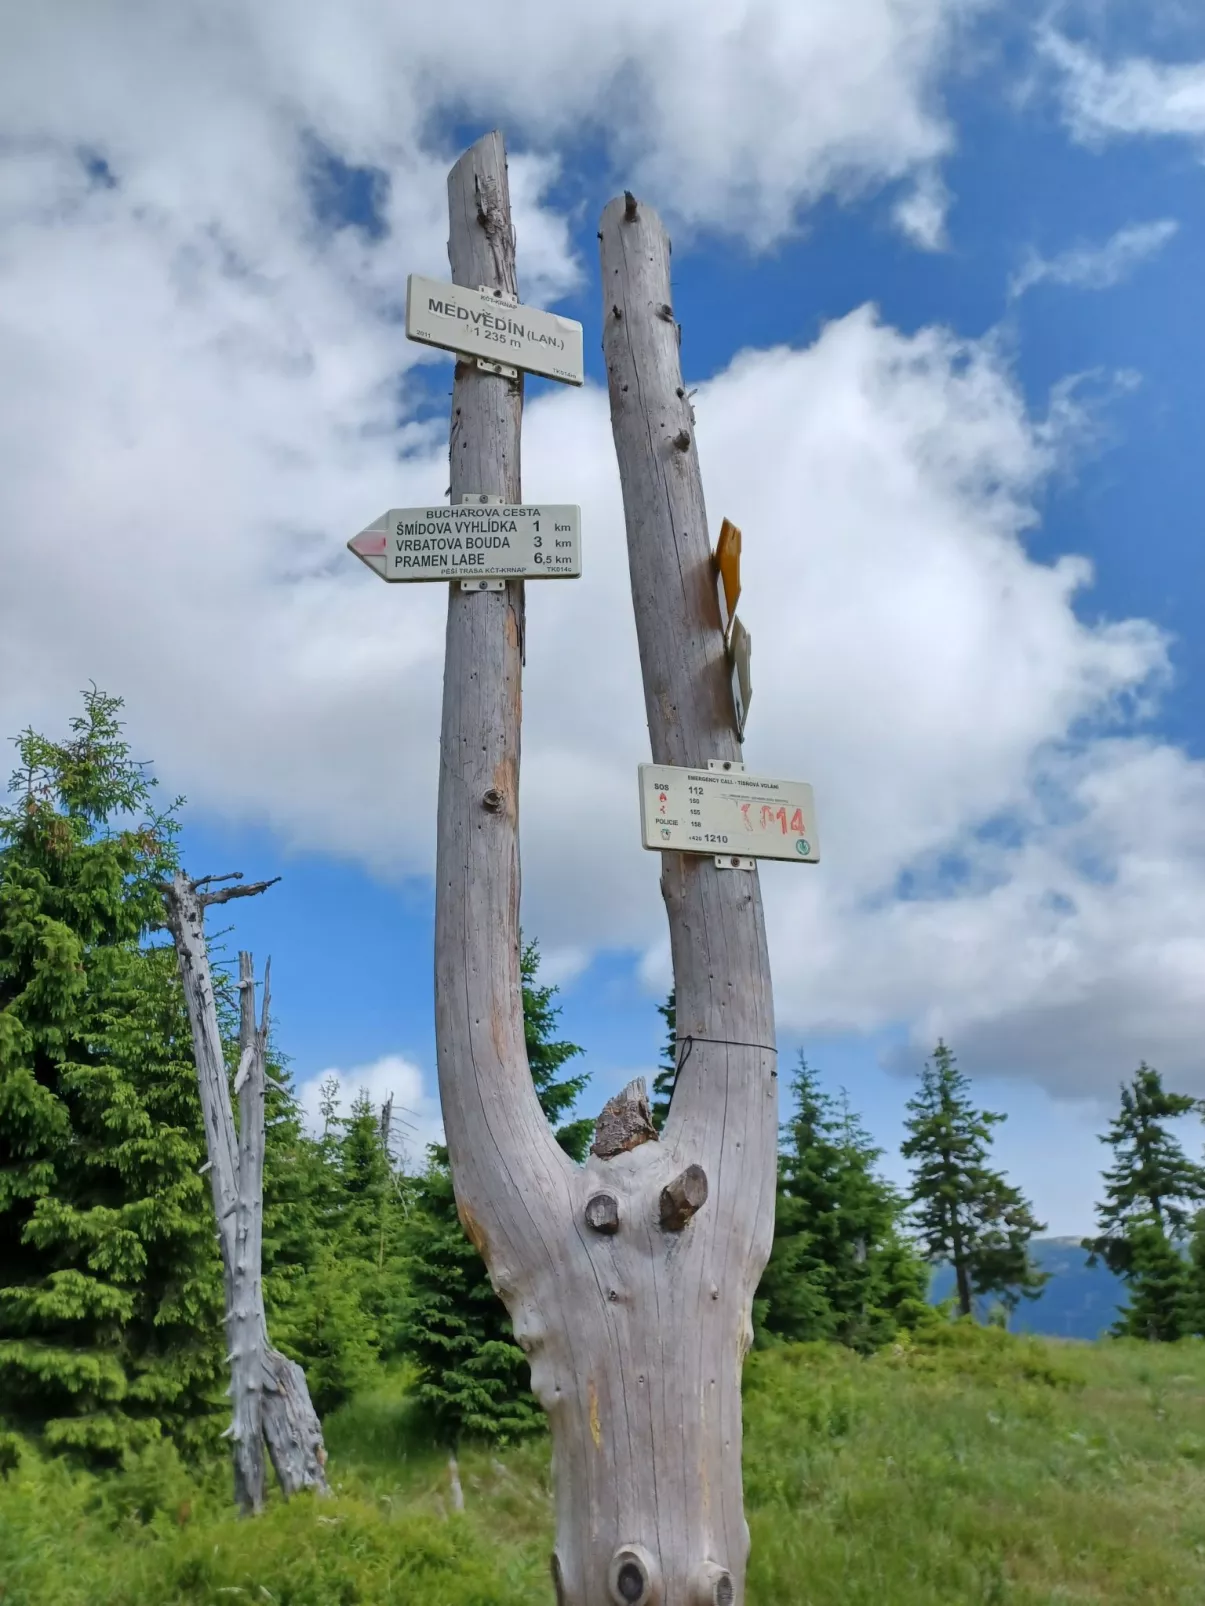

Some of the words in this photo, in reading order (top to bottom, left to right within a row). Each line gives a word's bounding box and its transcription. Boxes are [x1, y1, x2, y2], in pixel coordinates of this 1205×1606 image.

[428, 298, 525, 338] MEDVĚDÍN
[527, 330, 565, 350] (LAN.)
[416, 329, 431, 339] 2011
[484, 330, 507, 344] 235
[510, 338, 521, 348] m
[426, 508, 500, 519] BUCHAROVA
[502, 508, 541, 517] CESTA
[396, 519, 452, 536] ŠMÍDOVA
[454, 518, 518, 533] VYHLÍDKA
[533, 521, 540, 532] 1
[554, 523, 571, 532] km
[396, 538, 462, 552] VRBATOVA
[466, 536, 510, 550] BOUDA
[533, 536, 543, 548] 3
[555, 539, 572, 548] km
[394, 554, 448, 568] PRAMEN
[452, 554, 485, 566] LABE
[534, 552, 552, 565] 6,5
[555, 555, 572, 564] km
[688, 775, 719, 784] EMERGENCY
[654, 783, 670, 791] SOS
[688, 786, 704, 795] 112
[704, 834, 728, 844] 1210
